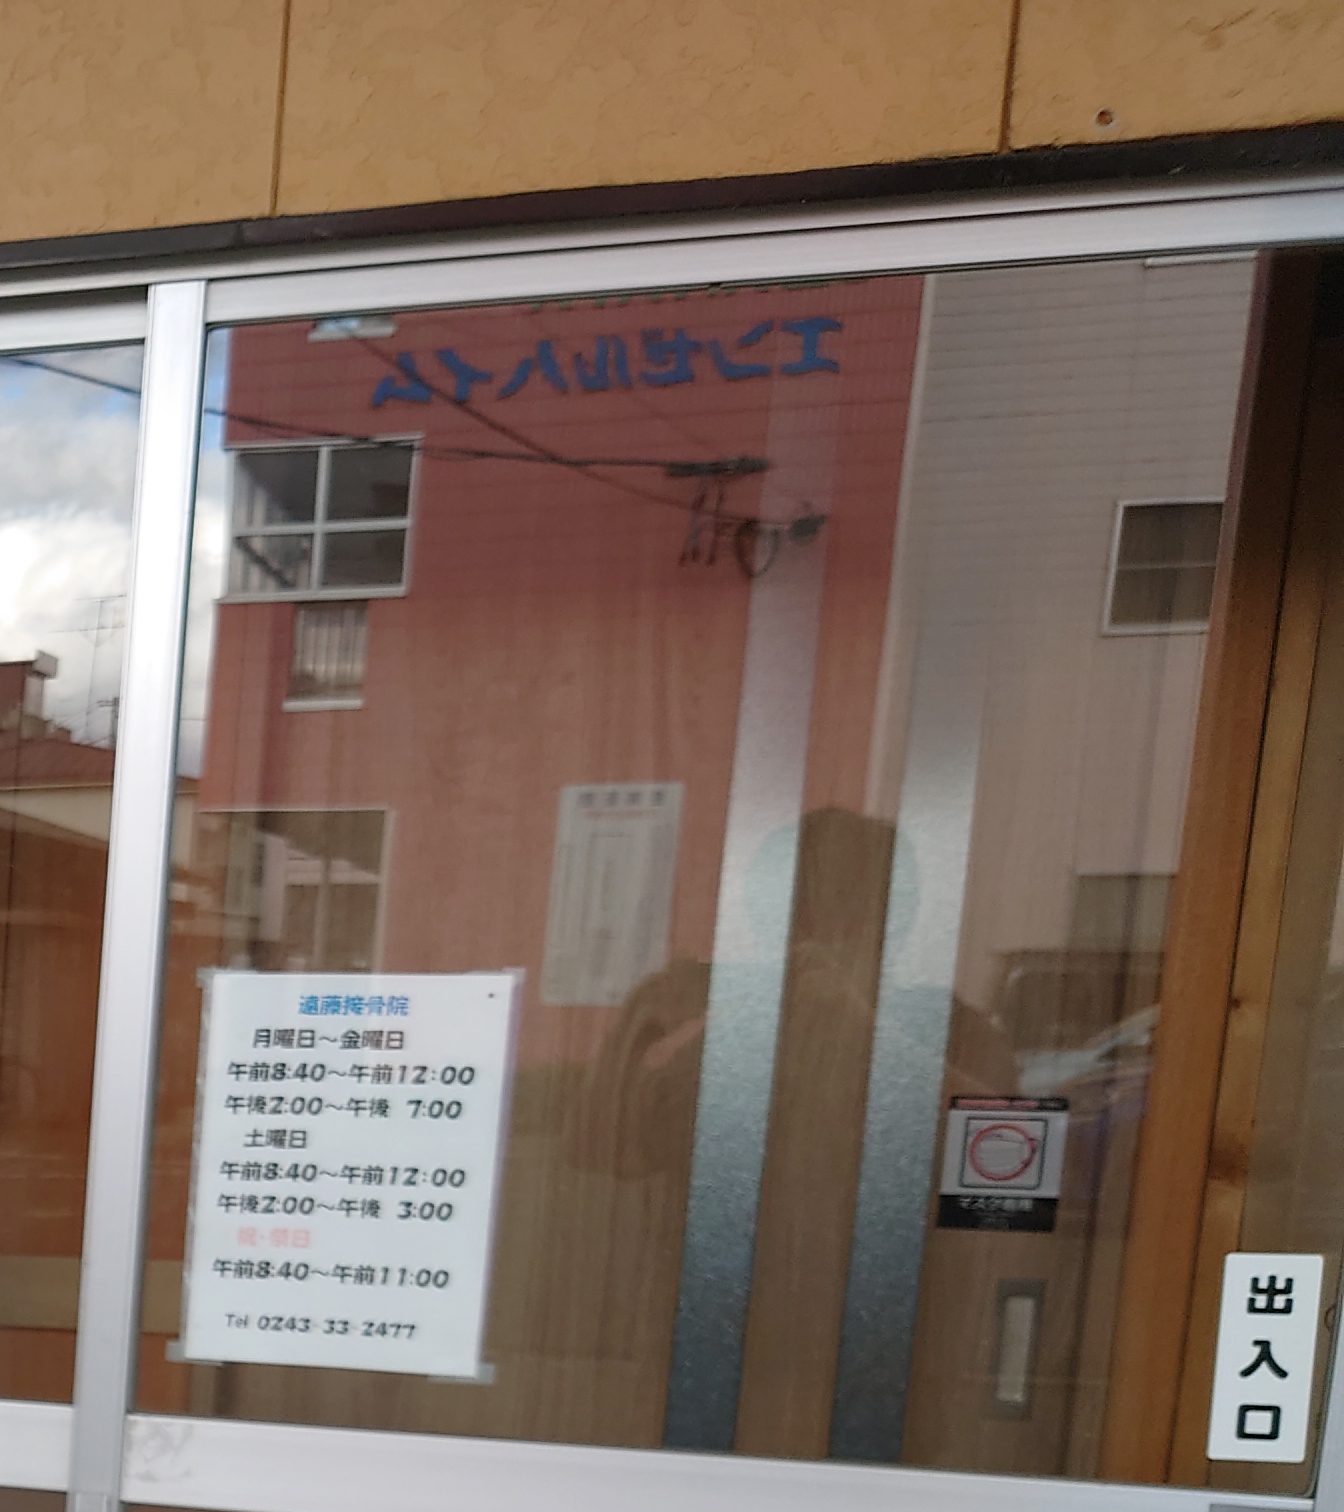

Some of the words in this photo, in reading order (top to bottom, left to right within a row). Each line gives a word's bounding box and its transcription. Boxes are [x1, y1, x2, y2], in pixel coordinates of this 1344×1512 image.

[298, 995, 409, 1016] 遠藤接骨院
[252, 1028, 404, 1050] 月曜日～金曜日
[243, 1128, 307, 1149] 土曜日
[1234, 1274, 1294, 1441] 出入口
